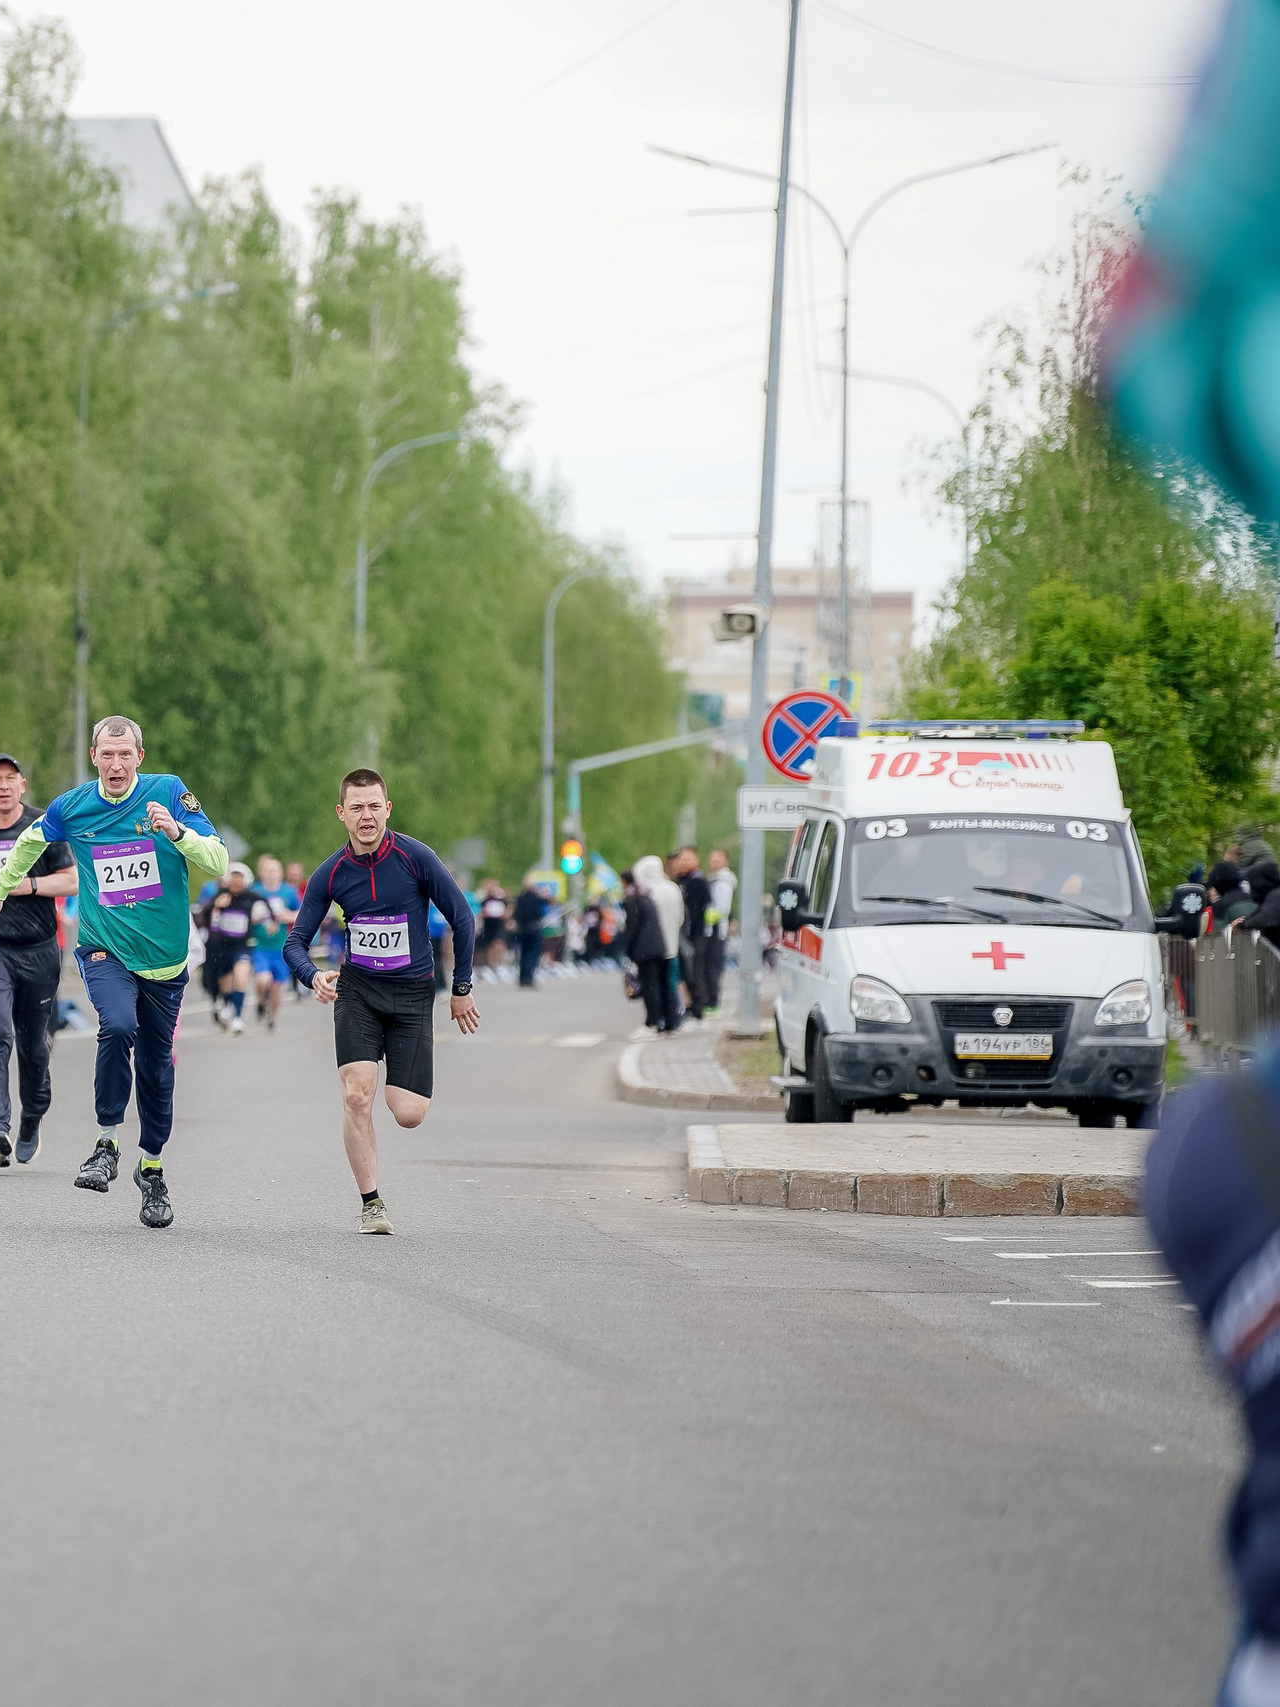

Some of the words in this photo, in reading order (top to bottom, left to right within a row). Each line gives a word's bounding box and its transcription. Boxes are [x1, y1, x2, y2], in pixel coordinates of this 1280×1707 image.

[867, 751, 953, 780] 103
[865, 818, 909, 840] 03
[928, 818, 1057, 833] ХАНТЫ-МАНСИЙСК
[1066, 820, 1109, 842] 03
[103, 860, 150, 884] 2149
[358, 931, 402, 949] 2207
